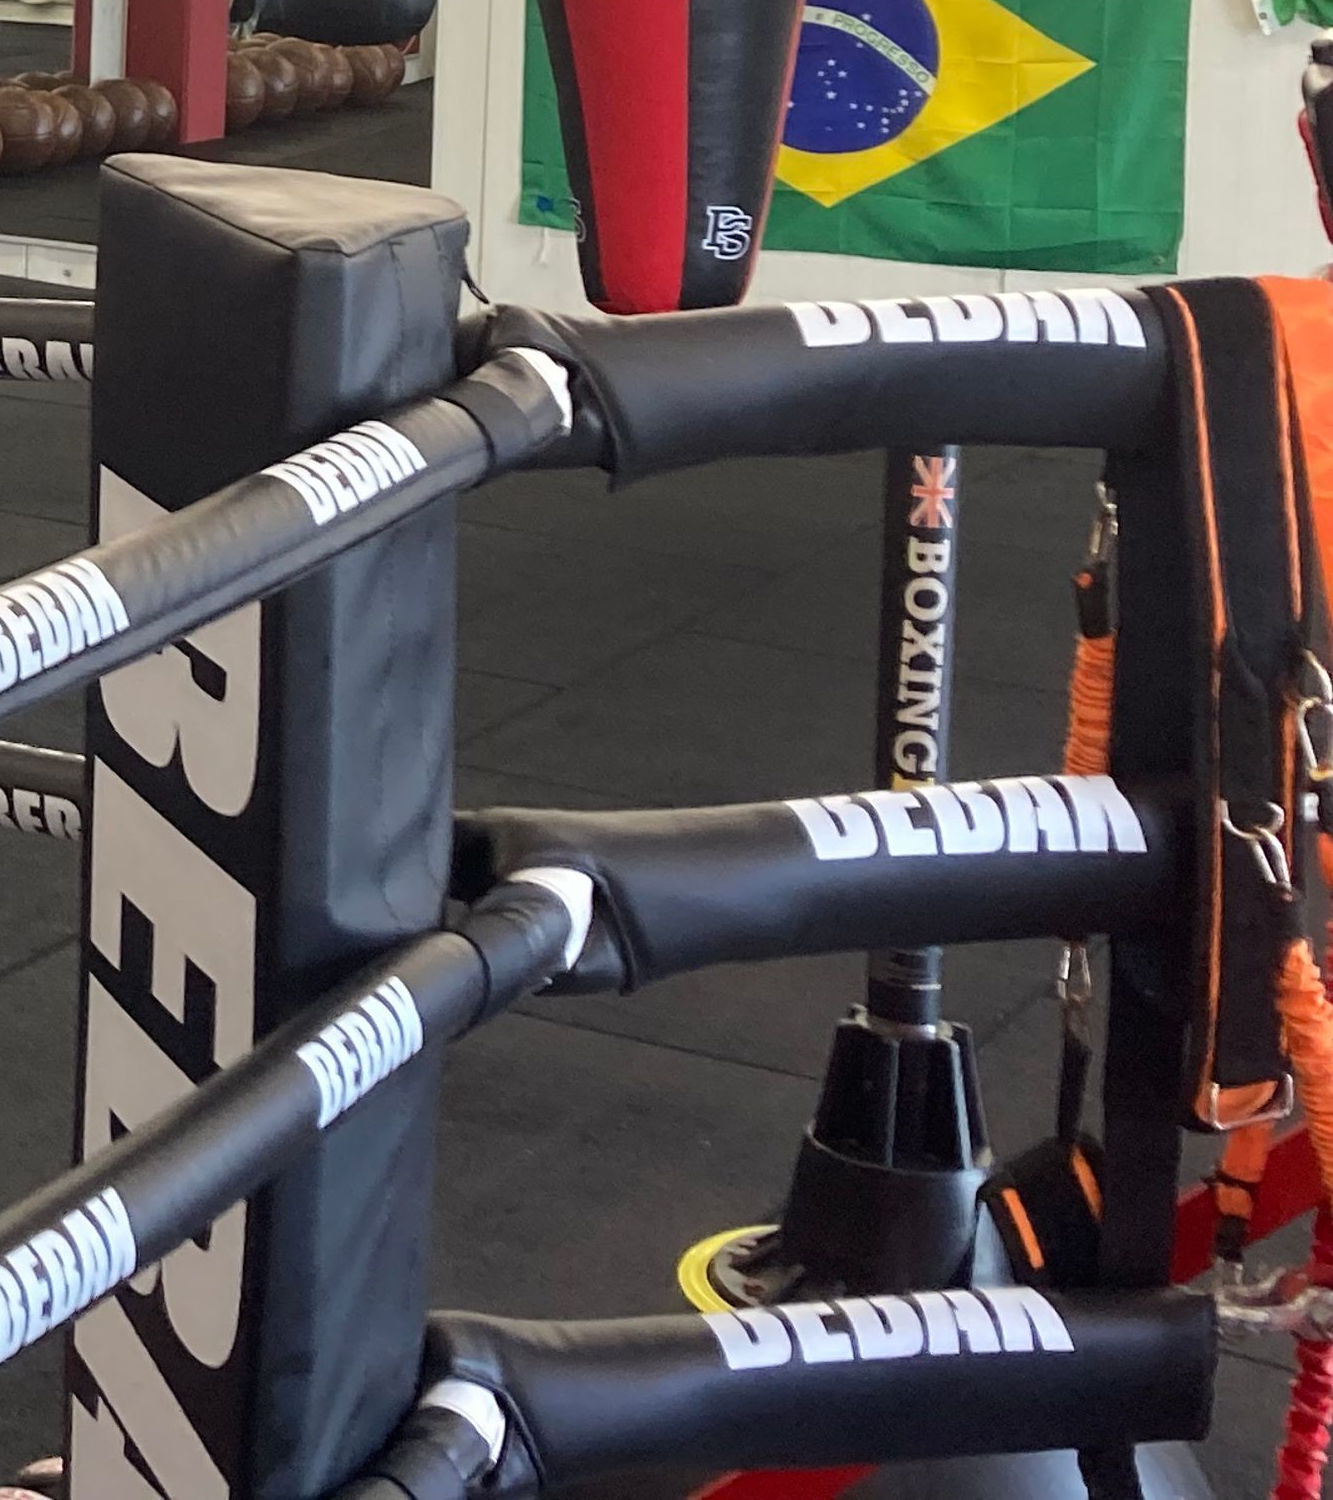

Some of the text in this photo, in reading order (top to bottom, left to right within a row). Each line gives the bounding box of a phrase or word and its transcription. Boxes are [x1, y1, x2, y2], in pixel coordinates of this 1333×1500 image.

[832, 13, 930, 84] PROGRESSO
[263, 420, 428, 526] BEBAK
[892, 536, 951, 776] BOXING
[296, 976, 424, 1130] BEBAK
